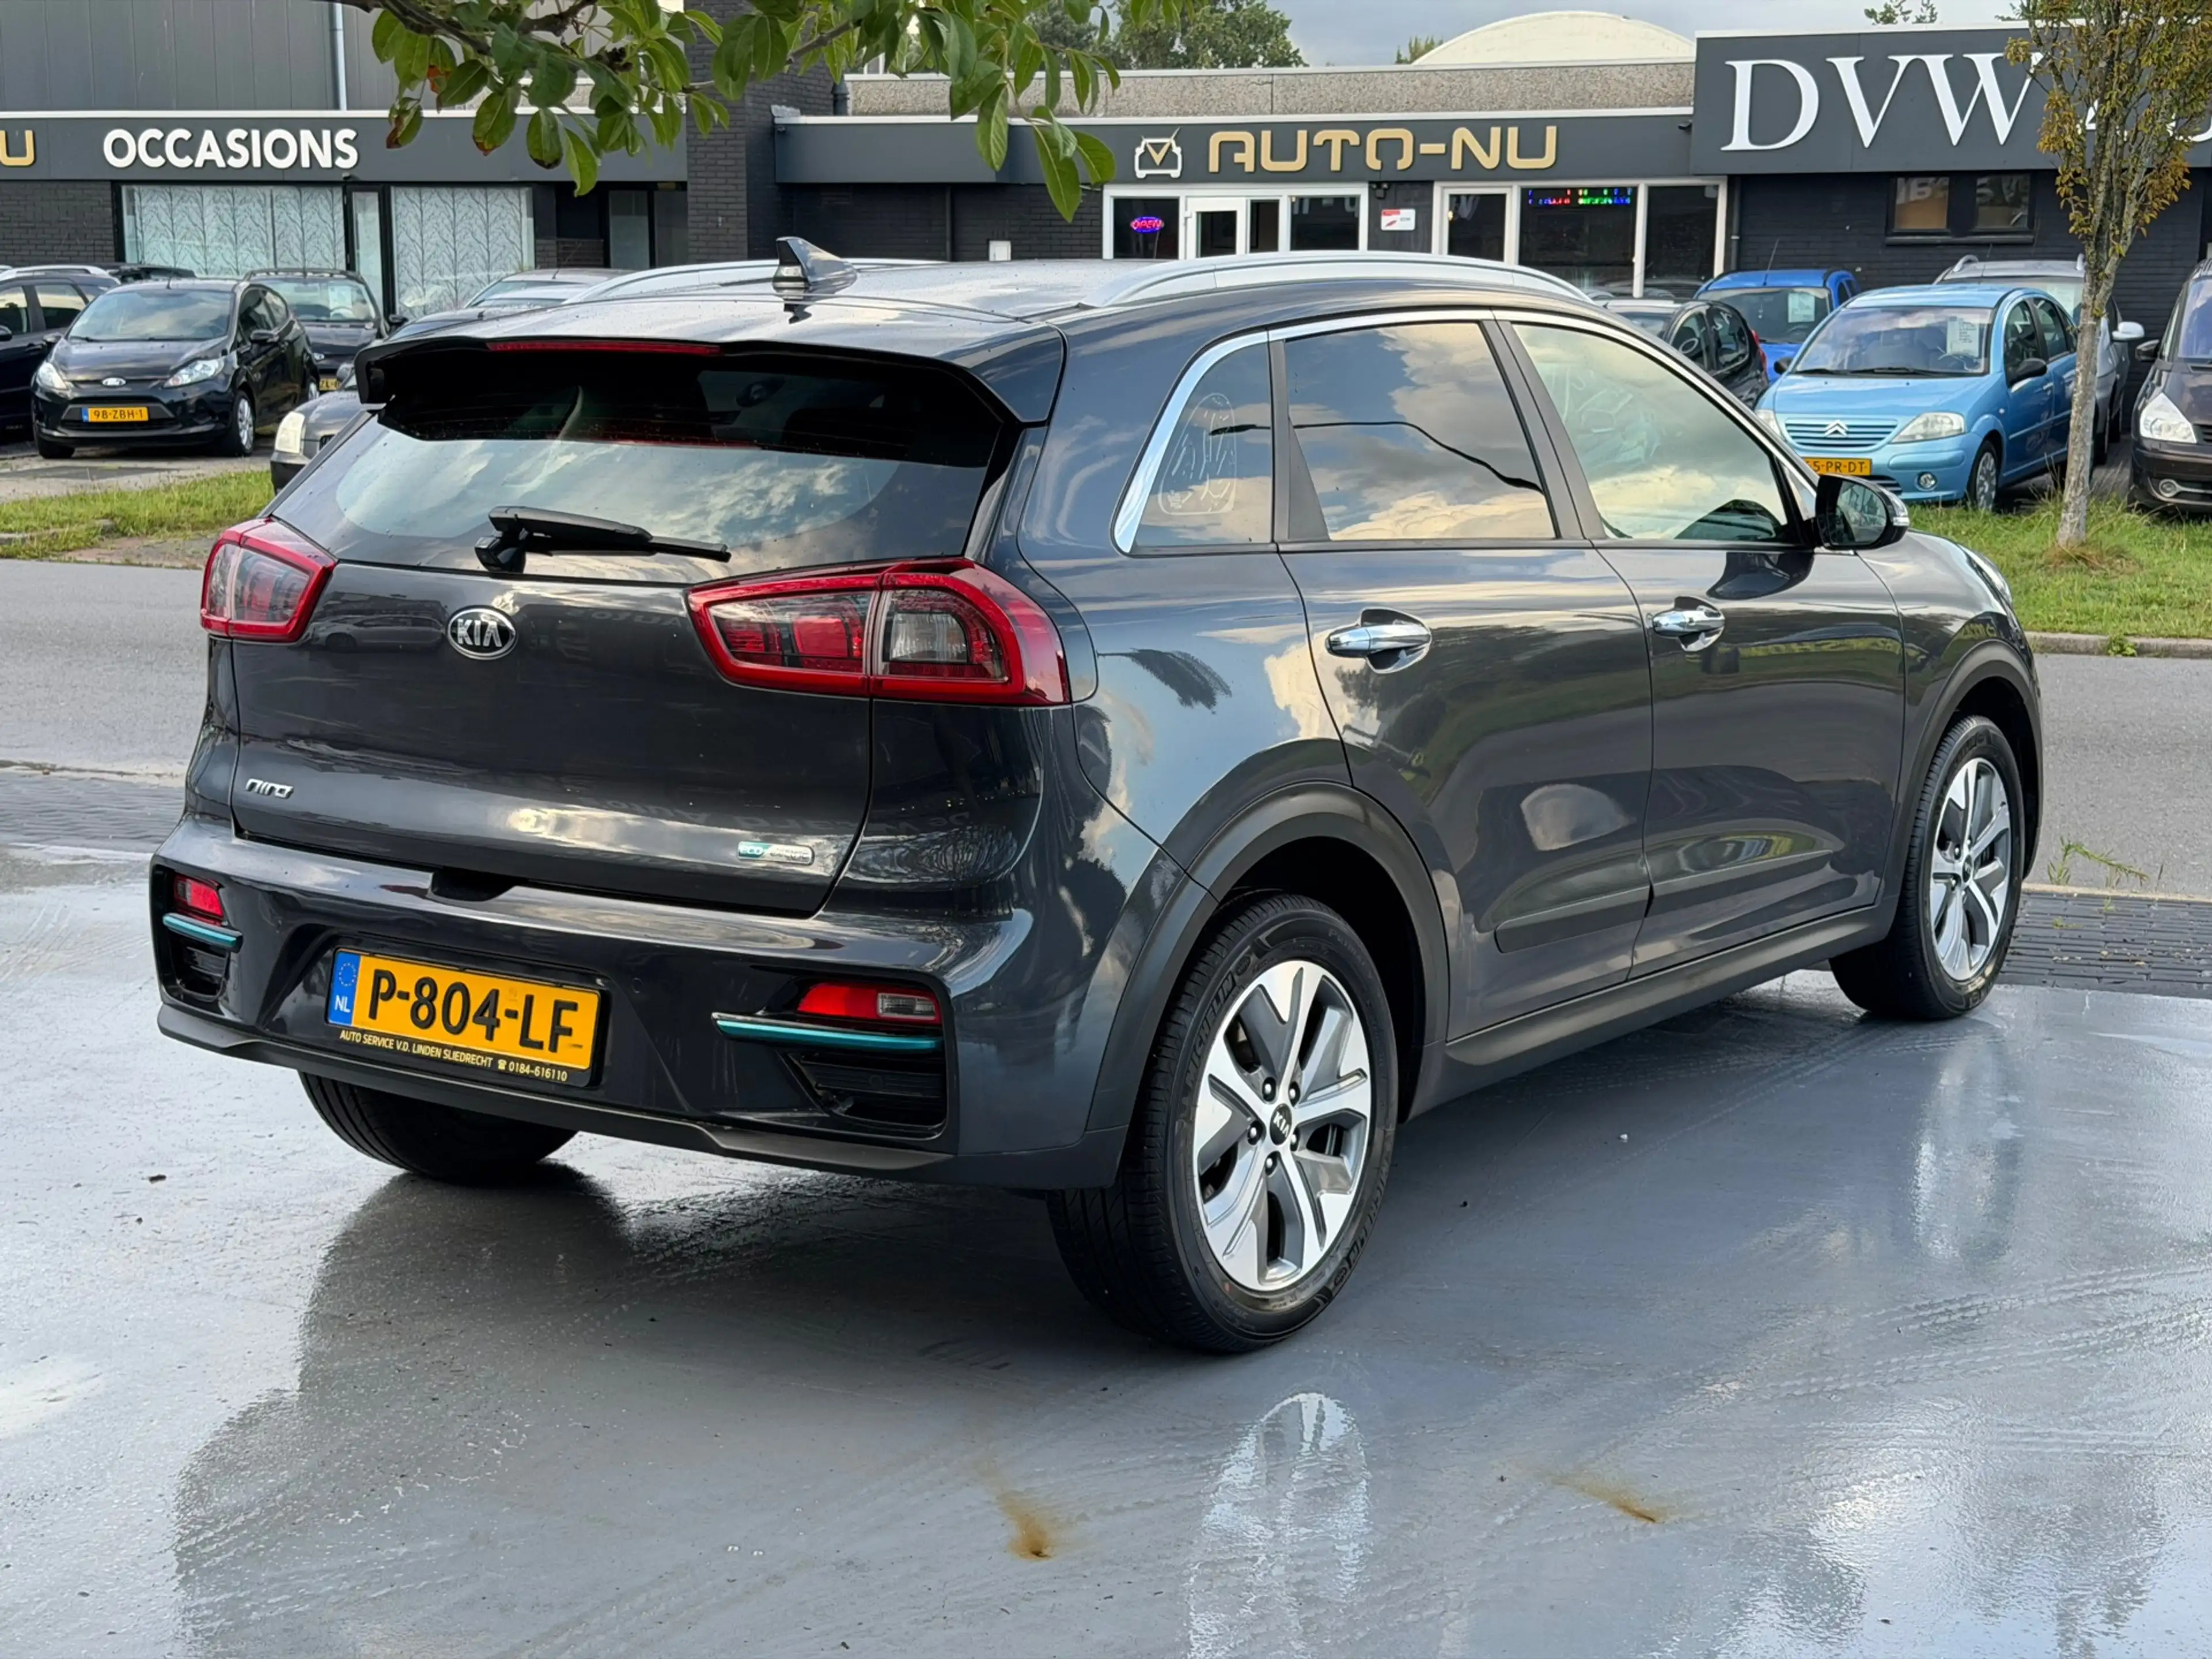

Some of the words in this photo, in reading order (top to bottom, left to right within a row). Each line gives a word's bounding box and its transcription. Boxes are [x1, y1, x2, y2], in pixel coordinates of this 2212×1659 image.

[1721, 52, 2043, 151] DVW
[103, 128, 358, 169] OCCASIONS
[1209, 125, 1557, 172] AUTO-NU
[1131, 219, 1162, 229] OPEN
[457, 618, 502, 647] KIA
[335, 995, 350, 1013] NL
[368, 969, 578, 1053] P-804-LF
[340, 1030, 361, 1043] AUTO
[362, 1035, 395, 1049] SERVICE
[396, 1040, 411, 1052] V.D.
[412, 1043, 442, 1058] LINDEN
[443, 1048, 494, 1067] SLIEDRECHT
[508, 1061, 568, 1082] 0184-616110
[1273, 1111, 1290, 1138] KIA
